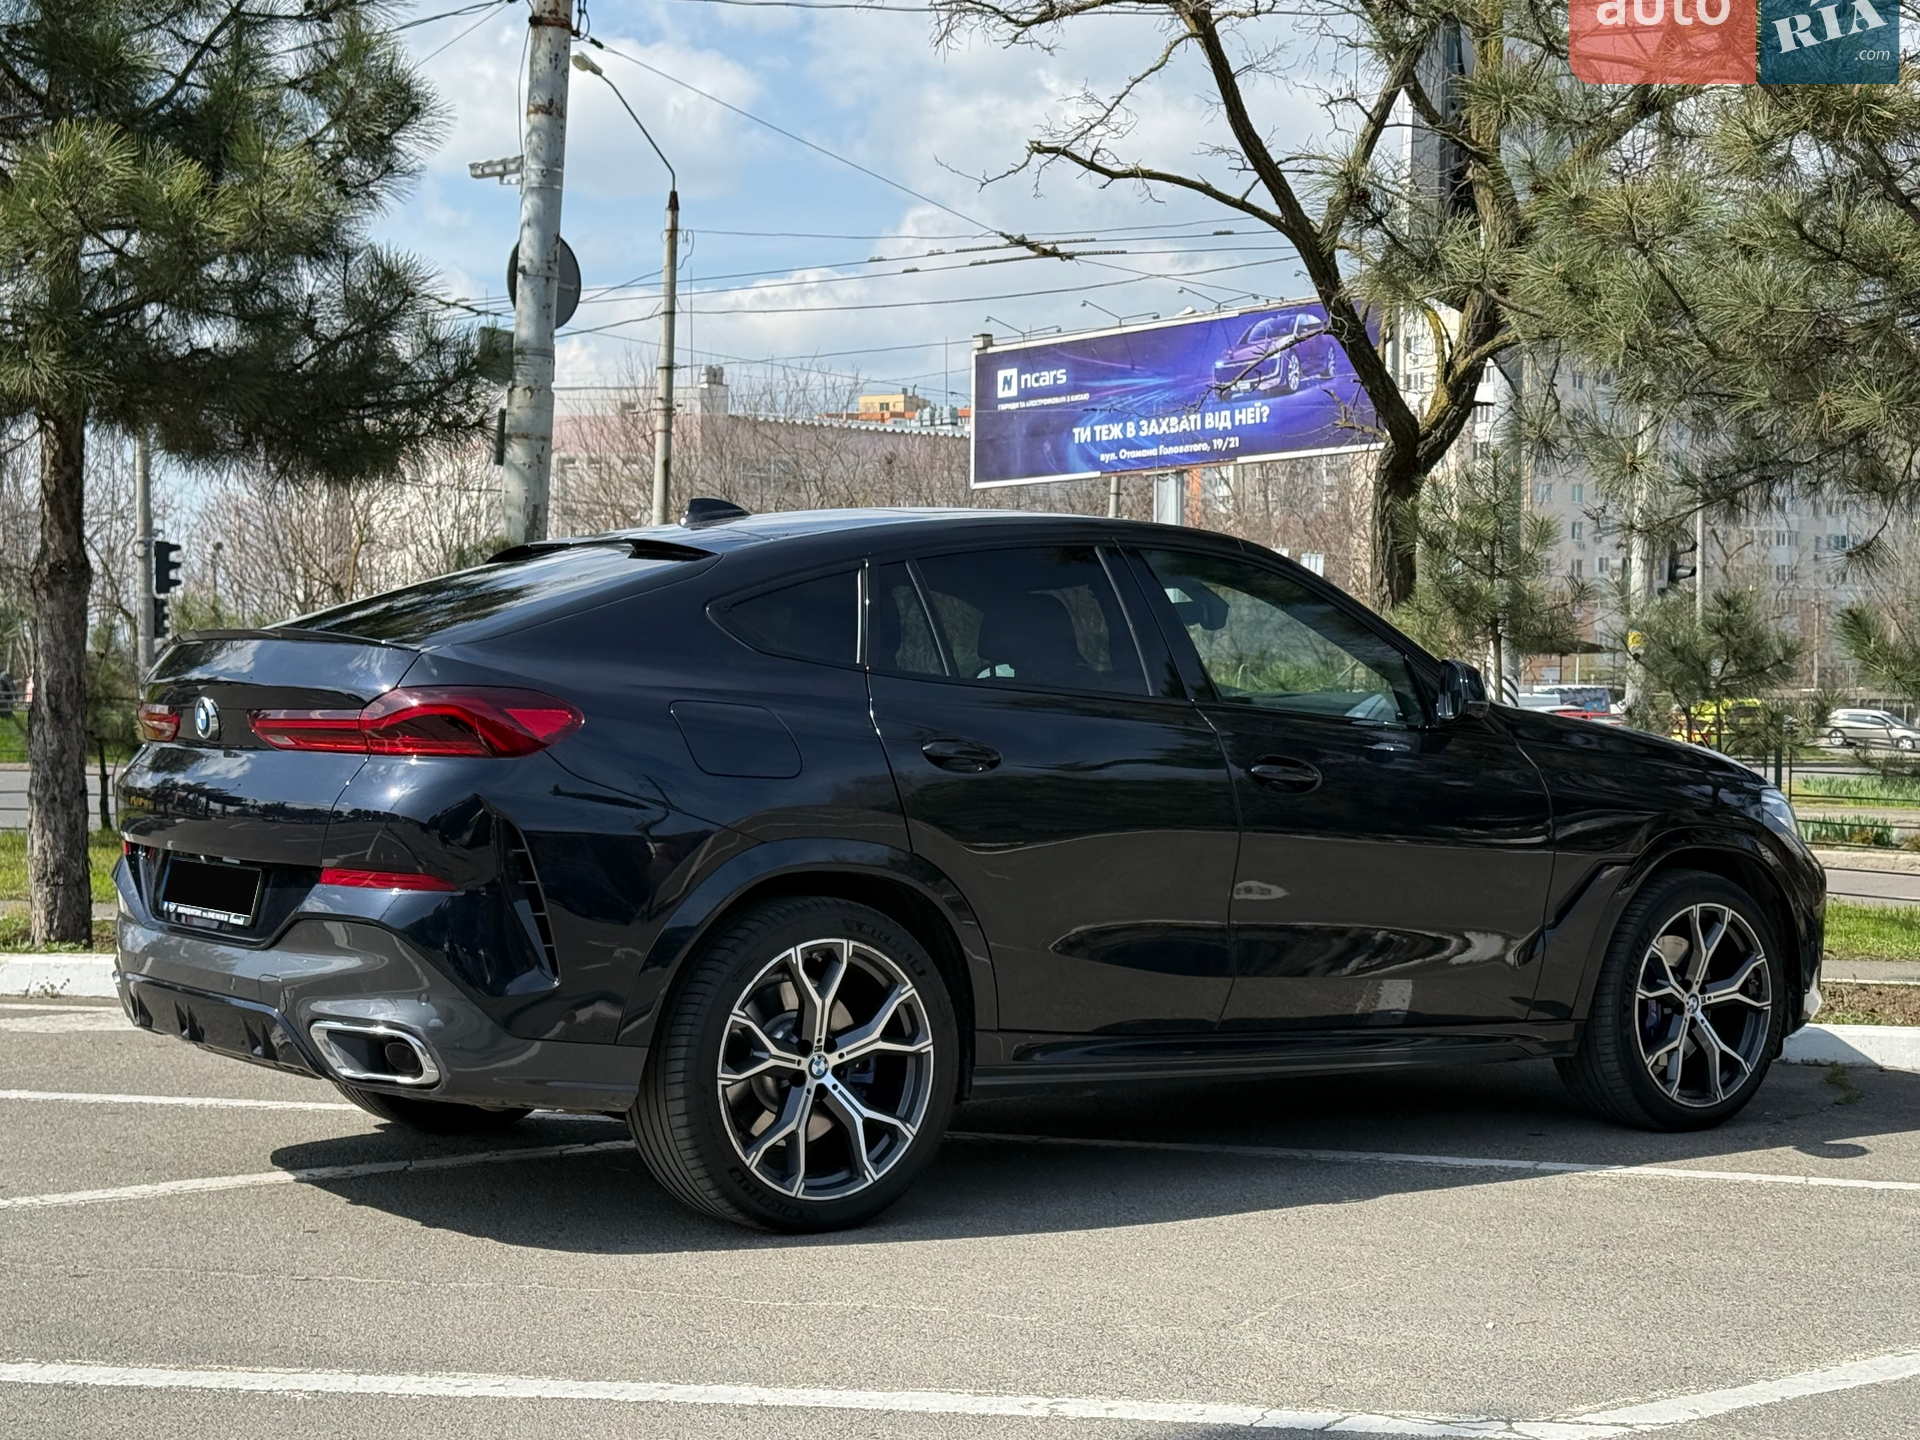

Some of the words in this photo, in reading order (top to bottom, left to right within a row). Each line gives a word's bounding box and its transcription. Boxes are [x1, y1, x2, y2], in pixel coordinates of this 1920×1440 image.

[1021, 368, 1067, 389] ncars
[1072, 425, 1092, 444] ТИ
[1094, 422, 1123, 442] ТЕЖ
[1126, 421, 1136, 439] В
[1139, 413, 1201, 437] ЗАХВАТІ
[1205, 411, 1232, 431] ВІД
[1235, 402, 1270, 427] НЕЇ?
[1100, 451, 1117, 463] вул.
[1119, 446, 1157, 460] Отамана
[1213, 436, 1240, 452] 19/21
